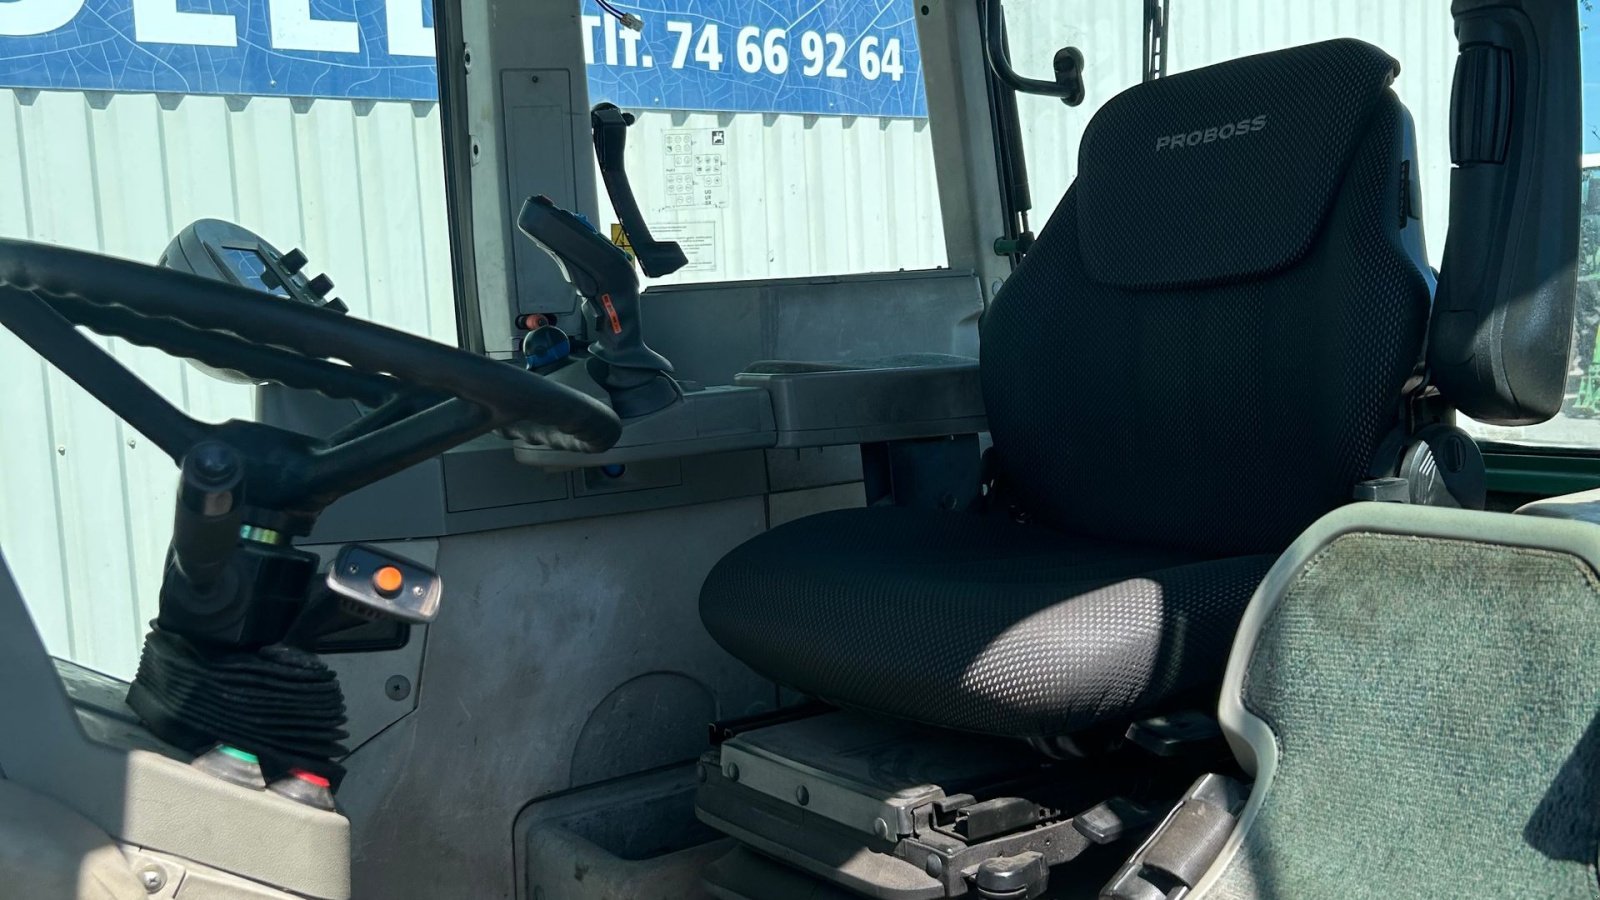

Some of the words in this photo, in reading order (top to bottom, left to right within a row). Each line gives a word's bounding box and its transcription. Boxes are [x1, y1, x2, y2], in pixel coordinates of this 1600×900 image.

[667, 20, 723, 71] 74
[736, 26, 789, 75] 66
[801, 30, 848, 78] 92
[859, 35, 904, 81] 64
[1156, 115, 1267, 151] PROBOSS
